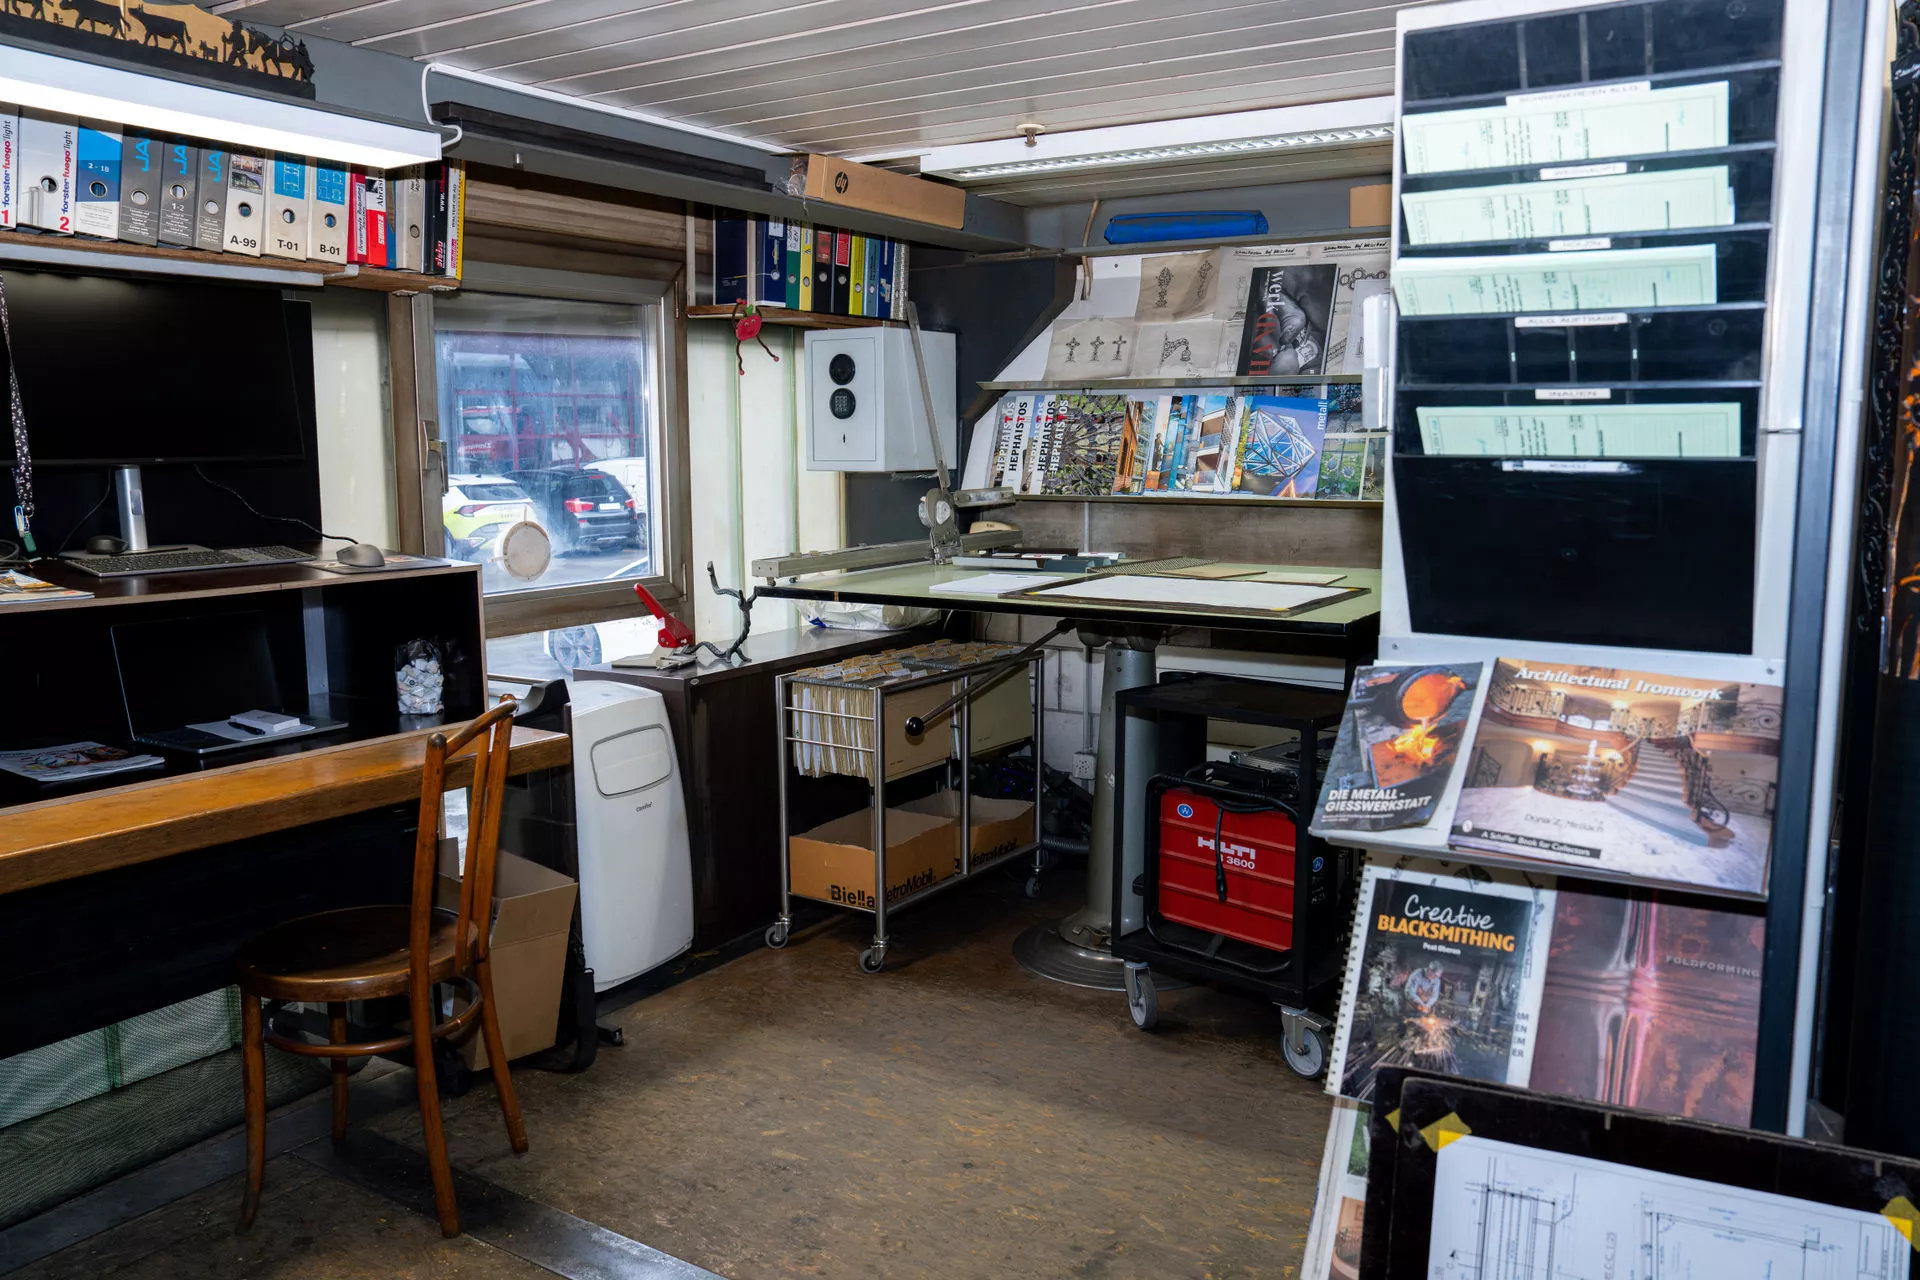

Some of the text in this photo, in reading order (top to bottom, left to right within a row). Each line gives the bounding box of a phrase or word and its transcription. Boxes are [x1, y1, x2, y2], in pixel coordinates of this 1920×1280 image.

[1, 209, 9, 225] 1
[59, 216, 70, 231] 2
[230, 234, 257, 249] A-99
[277, 239, 299, 251] T-01
[320, 244, 341, 256] B-01
[1266, 270, 1285, 312] werk
[1317, 400, 1328, 430] metall
[1008, 401, 1028, 472] HEPHAISTOS
[1037, 400, 1056, 471] HEPHAISTOS
[1049, 399, 1069, 472] HEPHAISTOS
[1514, 666, 1724, 700] Architectural Ironwork
[1325, 795, 1432, 812] GIESSWERKSTATT
[1328, 788, 1350, 801] DIE
[1197, 836, 1256, 860] HLTI
[1481, 831, 1489, 839] A
[1518, 836, 1538, 847] Book
[1539, 838, 1550, 849] for
[1551, 841, 1591, 857] Collectors
[1226, 855, 1256, 870] 3600
[830, 884, 876, 908] Biella
[1404, 894, 1495, 930] Creative
[1377, 914, 1516, 952] BLACKSMITHING
[1665, 954, 1761, 978] FOLDFORMING
